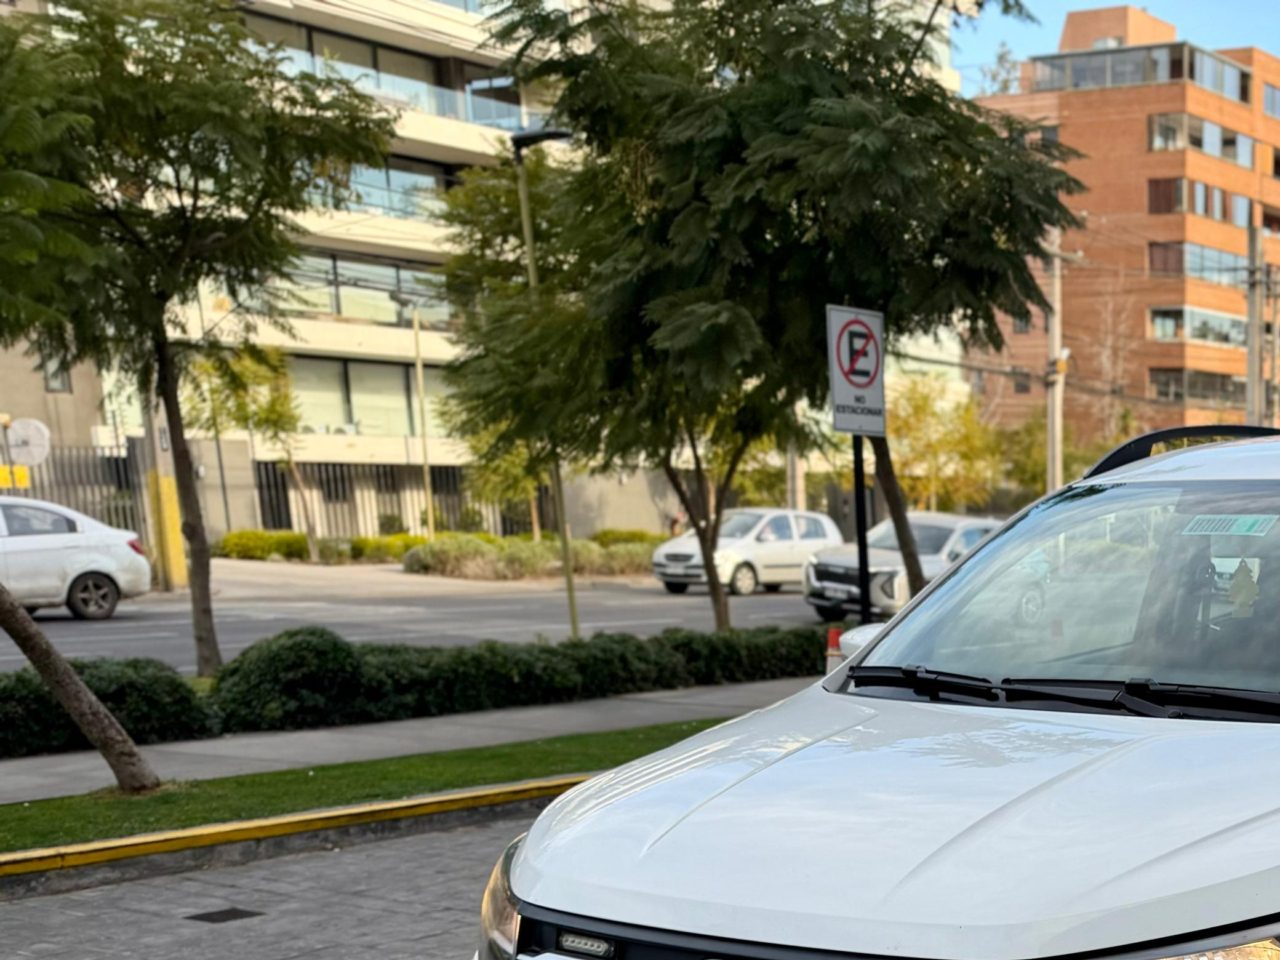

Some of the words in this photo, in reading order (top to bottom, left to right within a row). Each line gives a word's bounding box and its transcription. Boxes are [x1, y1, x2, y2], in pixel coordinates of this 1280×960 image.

[848, 329, 870, 377] E
[854, 395, 866, 405] NO
[836, 404, 882, 416] ESTACIONAR
